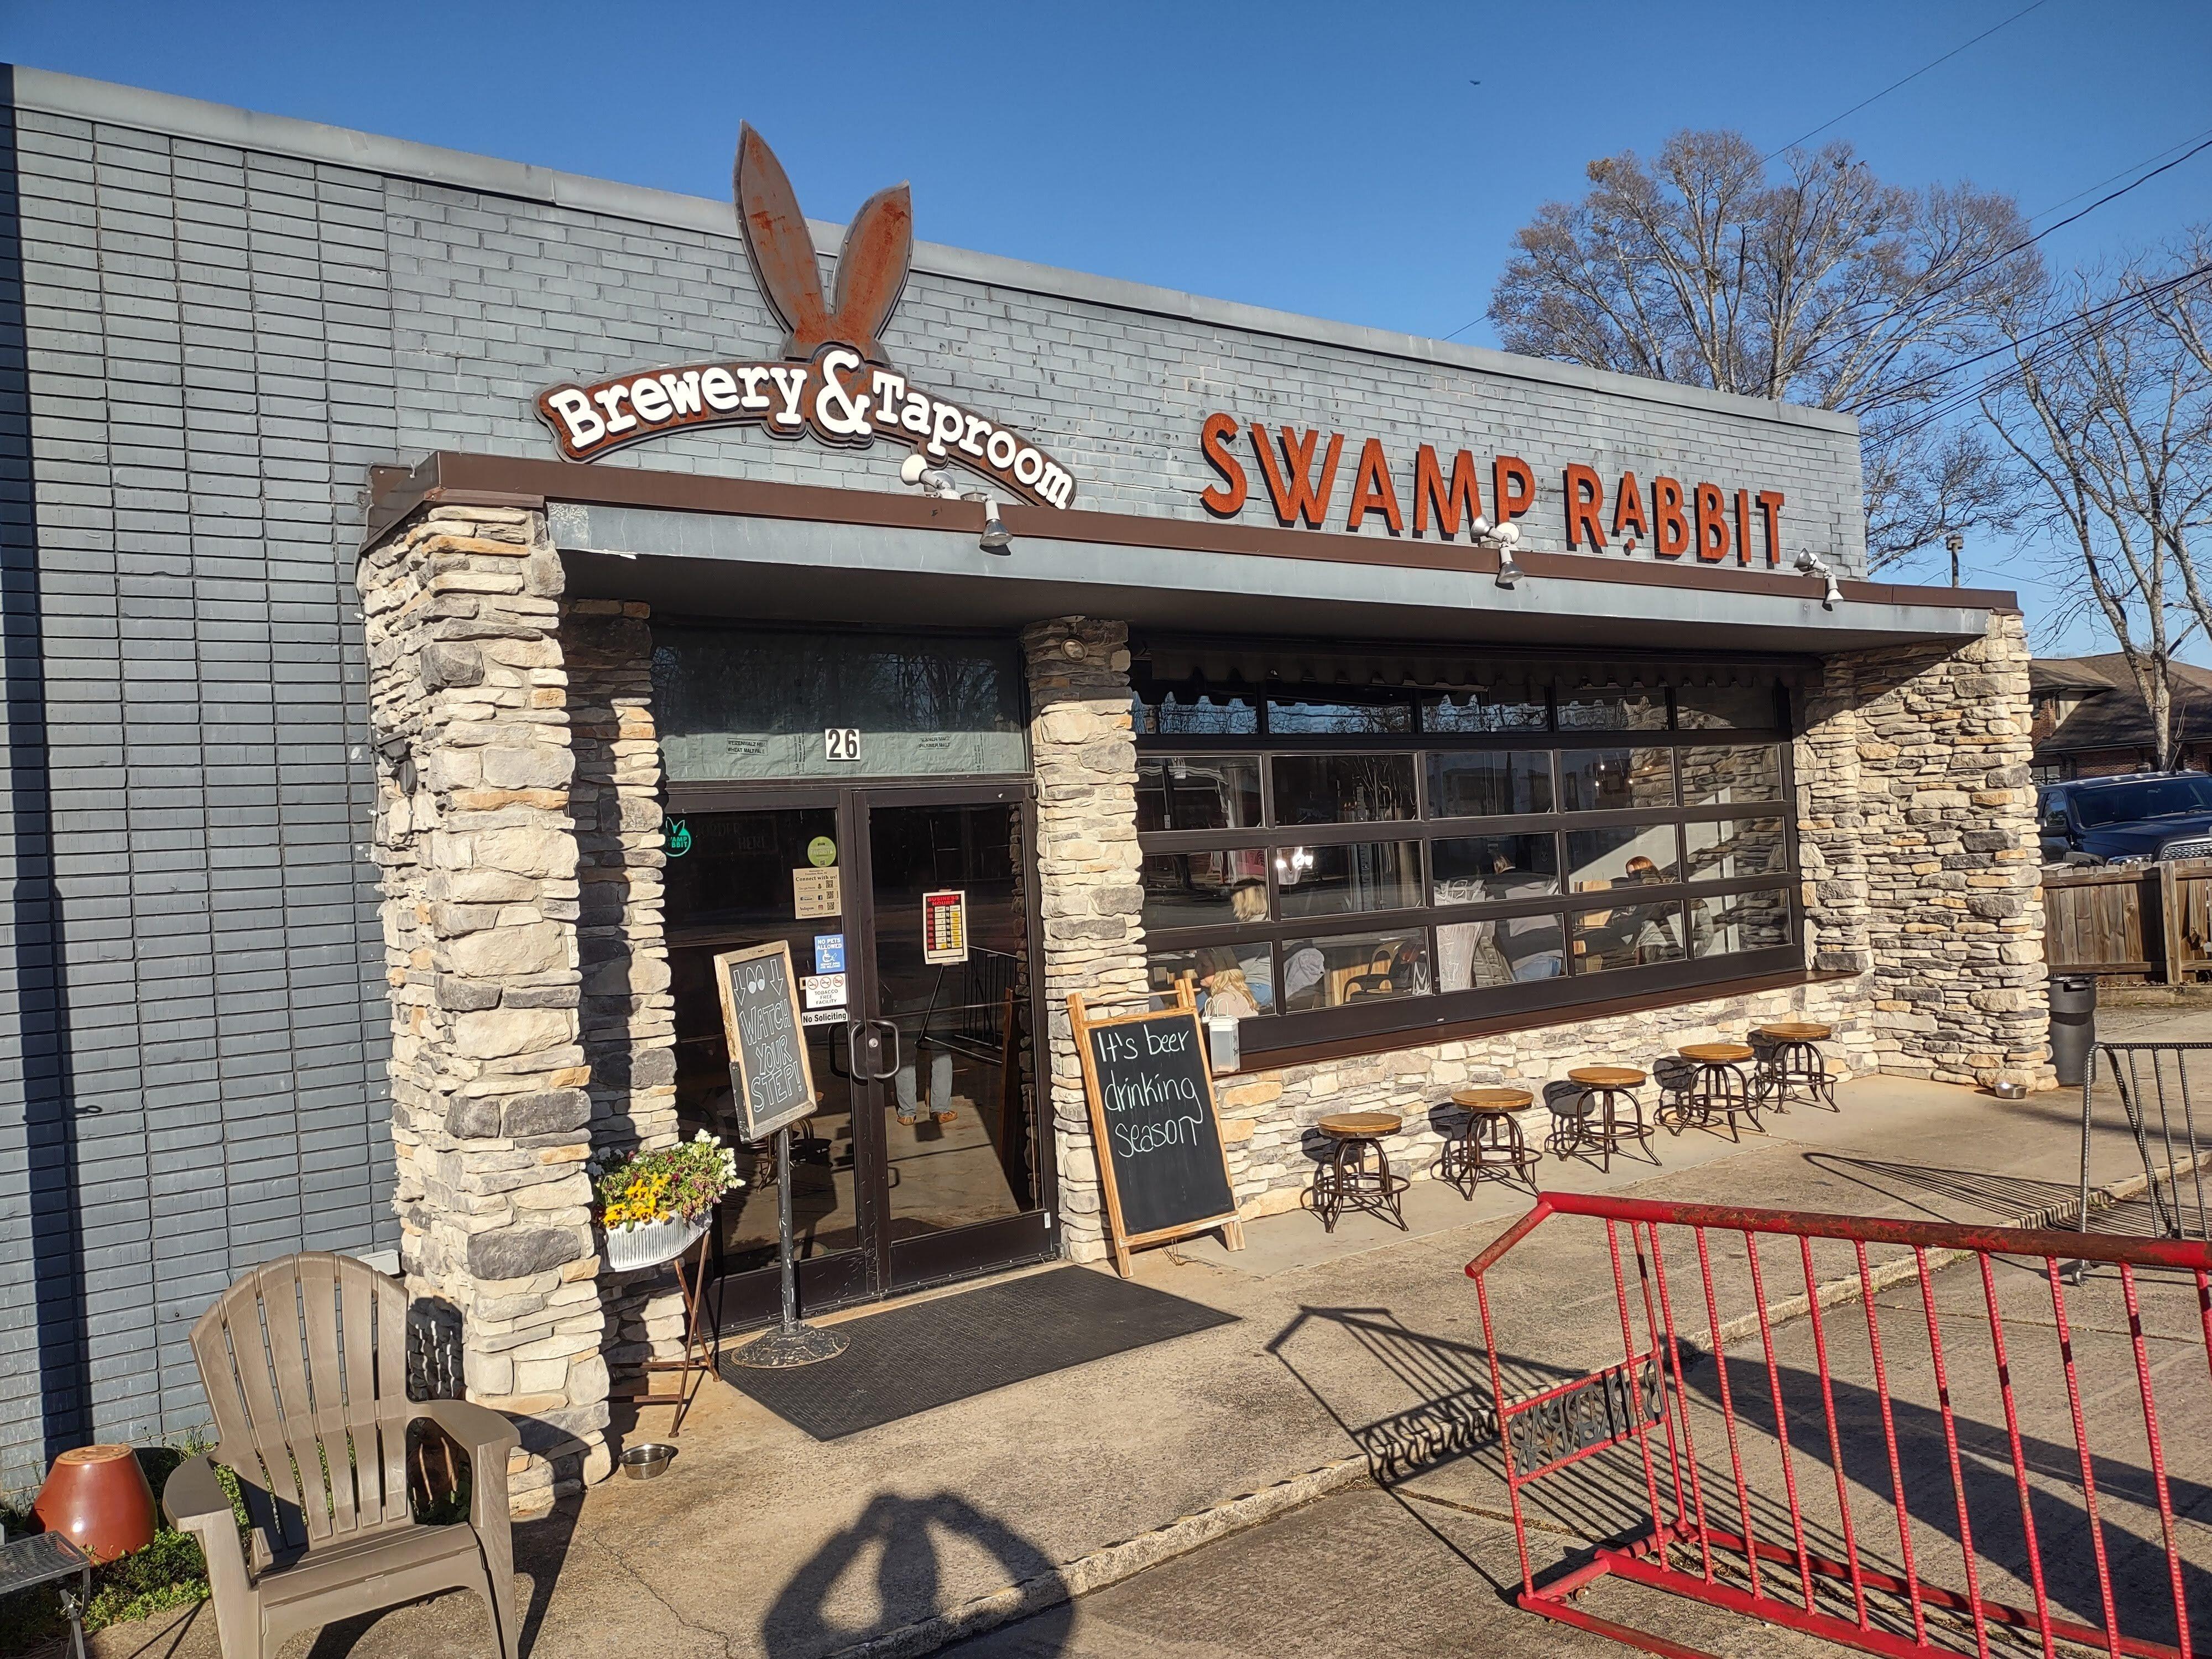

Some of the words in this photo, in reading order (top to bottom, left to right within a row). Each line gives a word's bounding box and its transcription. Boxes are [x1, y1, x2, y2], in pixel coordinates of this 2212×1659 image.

[547, 367, 806, 451] Brewery
[815, 349, 873, 436] &
[873, 370, 1078, 509] Taproom
[1201, 412, 1536, 534] SWAMP
[1566, 462, 1785, 564] RABBIT
[828, 729, 857, 758] 26
[738, 999, 791, 1046] WATCH
[814, 1011, 847, 1022] Soliciting
[755, 1035, 792, 1076] YOUR
[1097, 1031, 1139, 1062] It's
[1143, 1024, 1190, 1056] beer
[751, 1061, 802, 1113] STEP!
[1104, 1070, 1203, 1124] drinking
[1115, 1116, 1200, 1158] season
